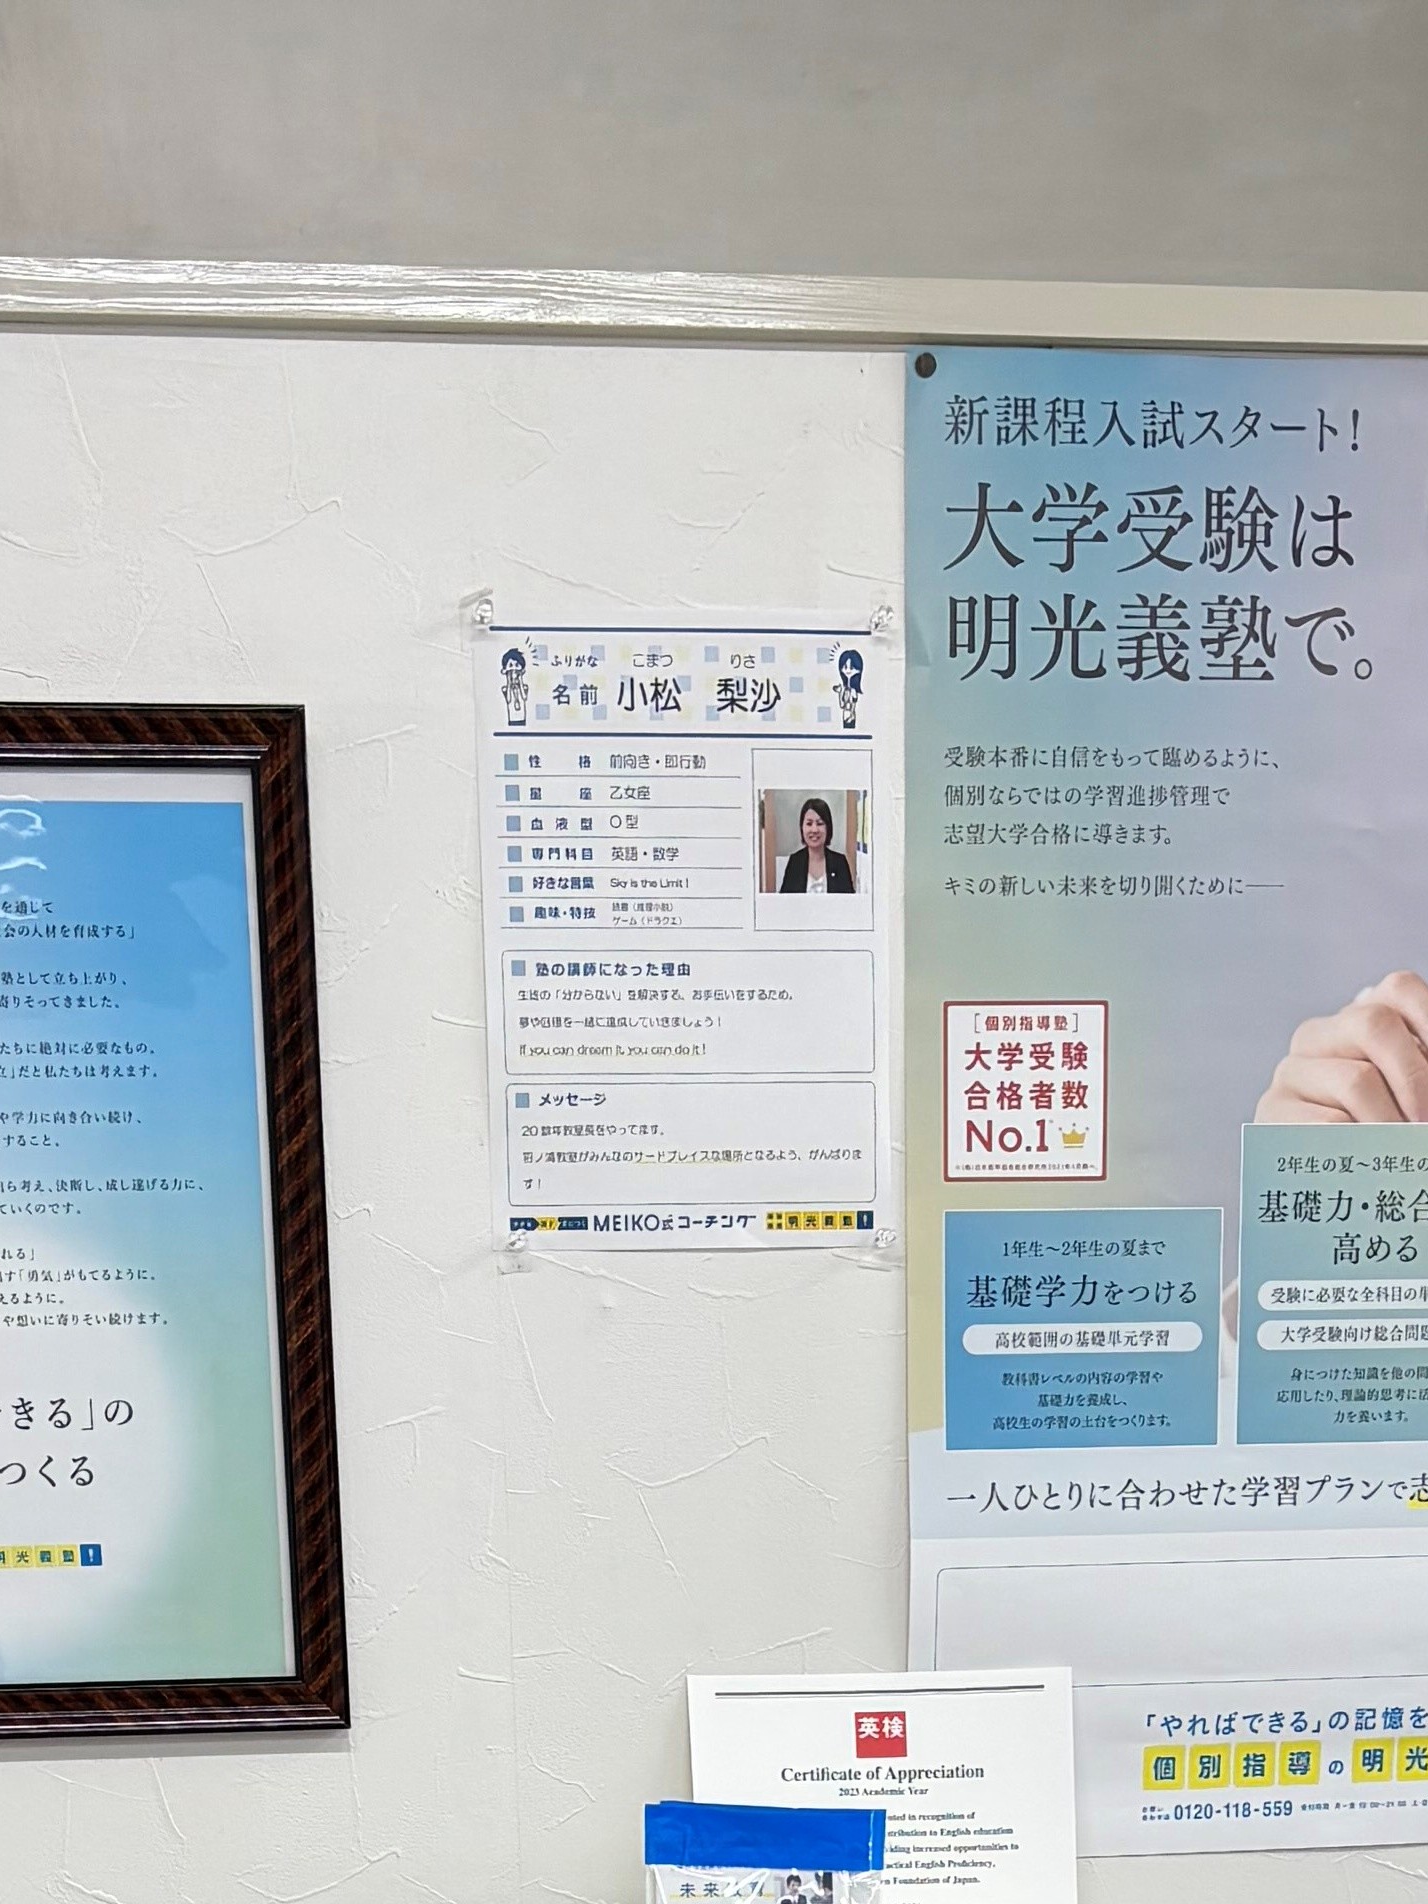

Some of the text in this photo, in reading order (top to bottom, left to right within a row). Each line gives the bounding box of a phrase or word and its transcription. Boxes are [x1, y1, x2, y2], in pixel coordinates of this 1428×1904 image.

[943, 482, 1355, 573] 大学受験は
[948, 593, 1373, 682] 明光義塾で。
[551, 653, 756, 669] ふりがな こまつ りさ
[552, 677, 781, 713] 名前 小松 梨沙
[610, 755, 706, 770] 前向き・即行動
[944, 746, 1279, 768] 受験本番に自信をもって臨めるように、
[610, 785, 651, 801] 乙女座
[944, 784, 1230, 807] 個別ならではの学習進捗管理で
[944, 823, 1174, 846] 志望大学合格に導きます。
[532, 847, 679, 862] 専門科目 英語・数学
[534, 907, 596, 920] 趣味・特技
[536, 962, 691, 977] 塾の講師になった理由
[964, 1042, 1089, 1071] 大学受験
[539, 1094, 606, 1106] メッセージ
[964, 1080, 1089, 1110] 合格者数
[593, 1214, 756, 1232] MEIKO式コーチング
[1333, 1232, 1419, 1264] 高める
[967, 1275, 1198, 1309] 基礎学力をつける
[996, 1328, 1170, 1349] 高校範囲の基礎単元学習
[1002, 1371, 1163, 1386] 教科書レベルの内容の学習や
[1037, 1392, 1128, 1408] 基礎力を養成し、
[993, 1414, 1173, 1430] 高校生の学習の土台をつくります。
[1333, 1409, 1412, 1425] 力を養います。
[857, 1716, 905, 1739] 英検
[781, 1764, 985, 1782] Certificate of Appreciation
[862, 1786, 928, 1796] Academic Year
[1174, 1800, 1294, 1820] 0120-118-559
[940, 1828, 971, 1837] English
[915, 1860, 945, 1870] English
